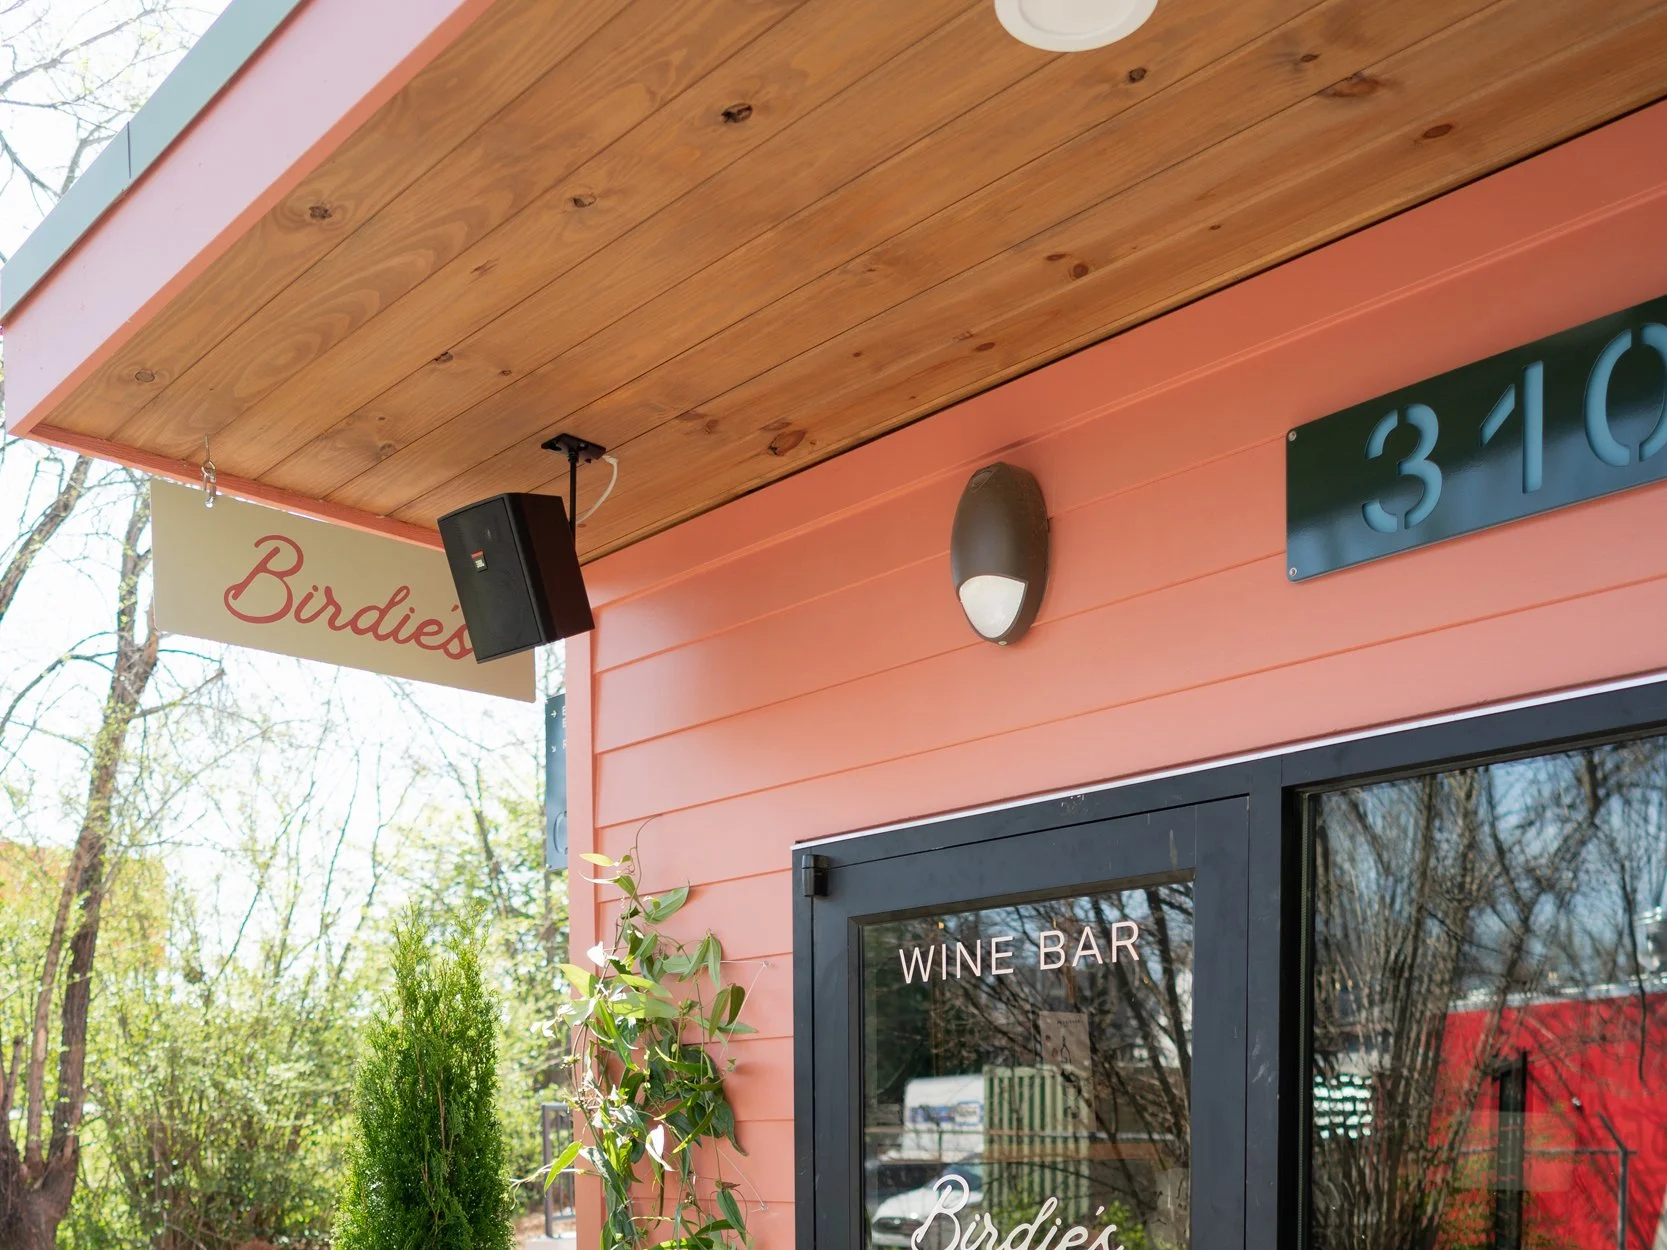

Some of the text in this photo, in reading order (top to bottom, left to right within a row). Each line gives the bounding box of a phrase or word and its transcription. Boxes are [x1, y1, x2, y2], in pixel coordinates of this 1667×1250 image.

[1361, 323, 1667, 533] 310
[899, 921, 1139, 984] WINE BAR
